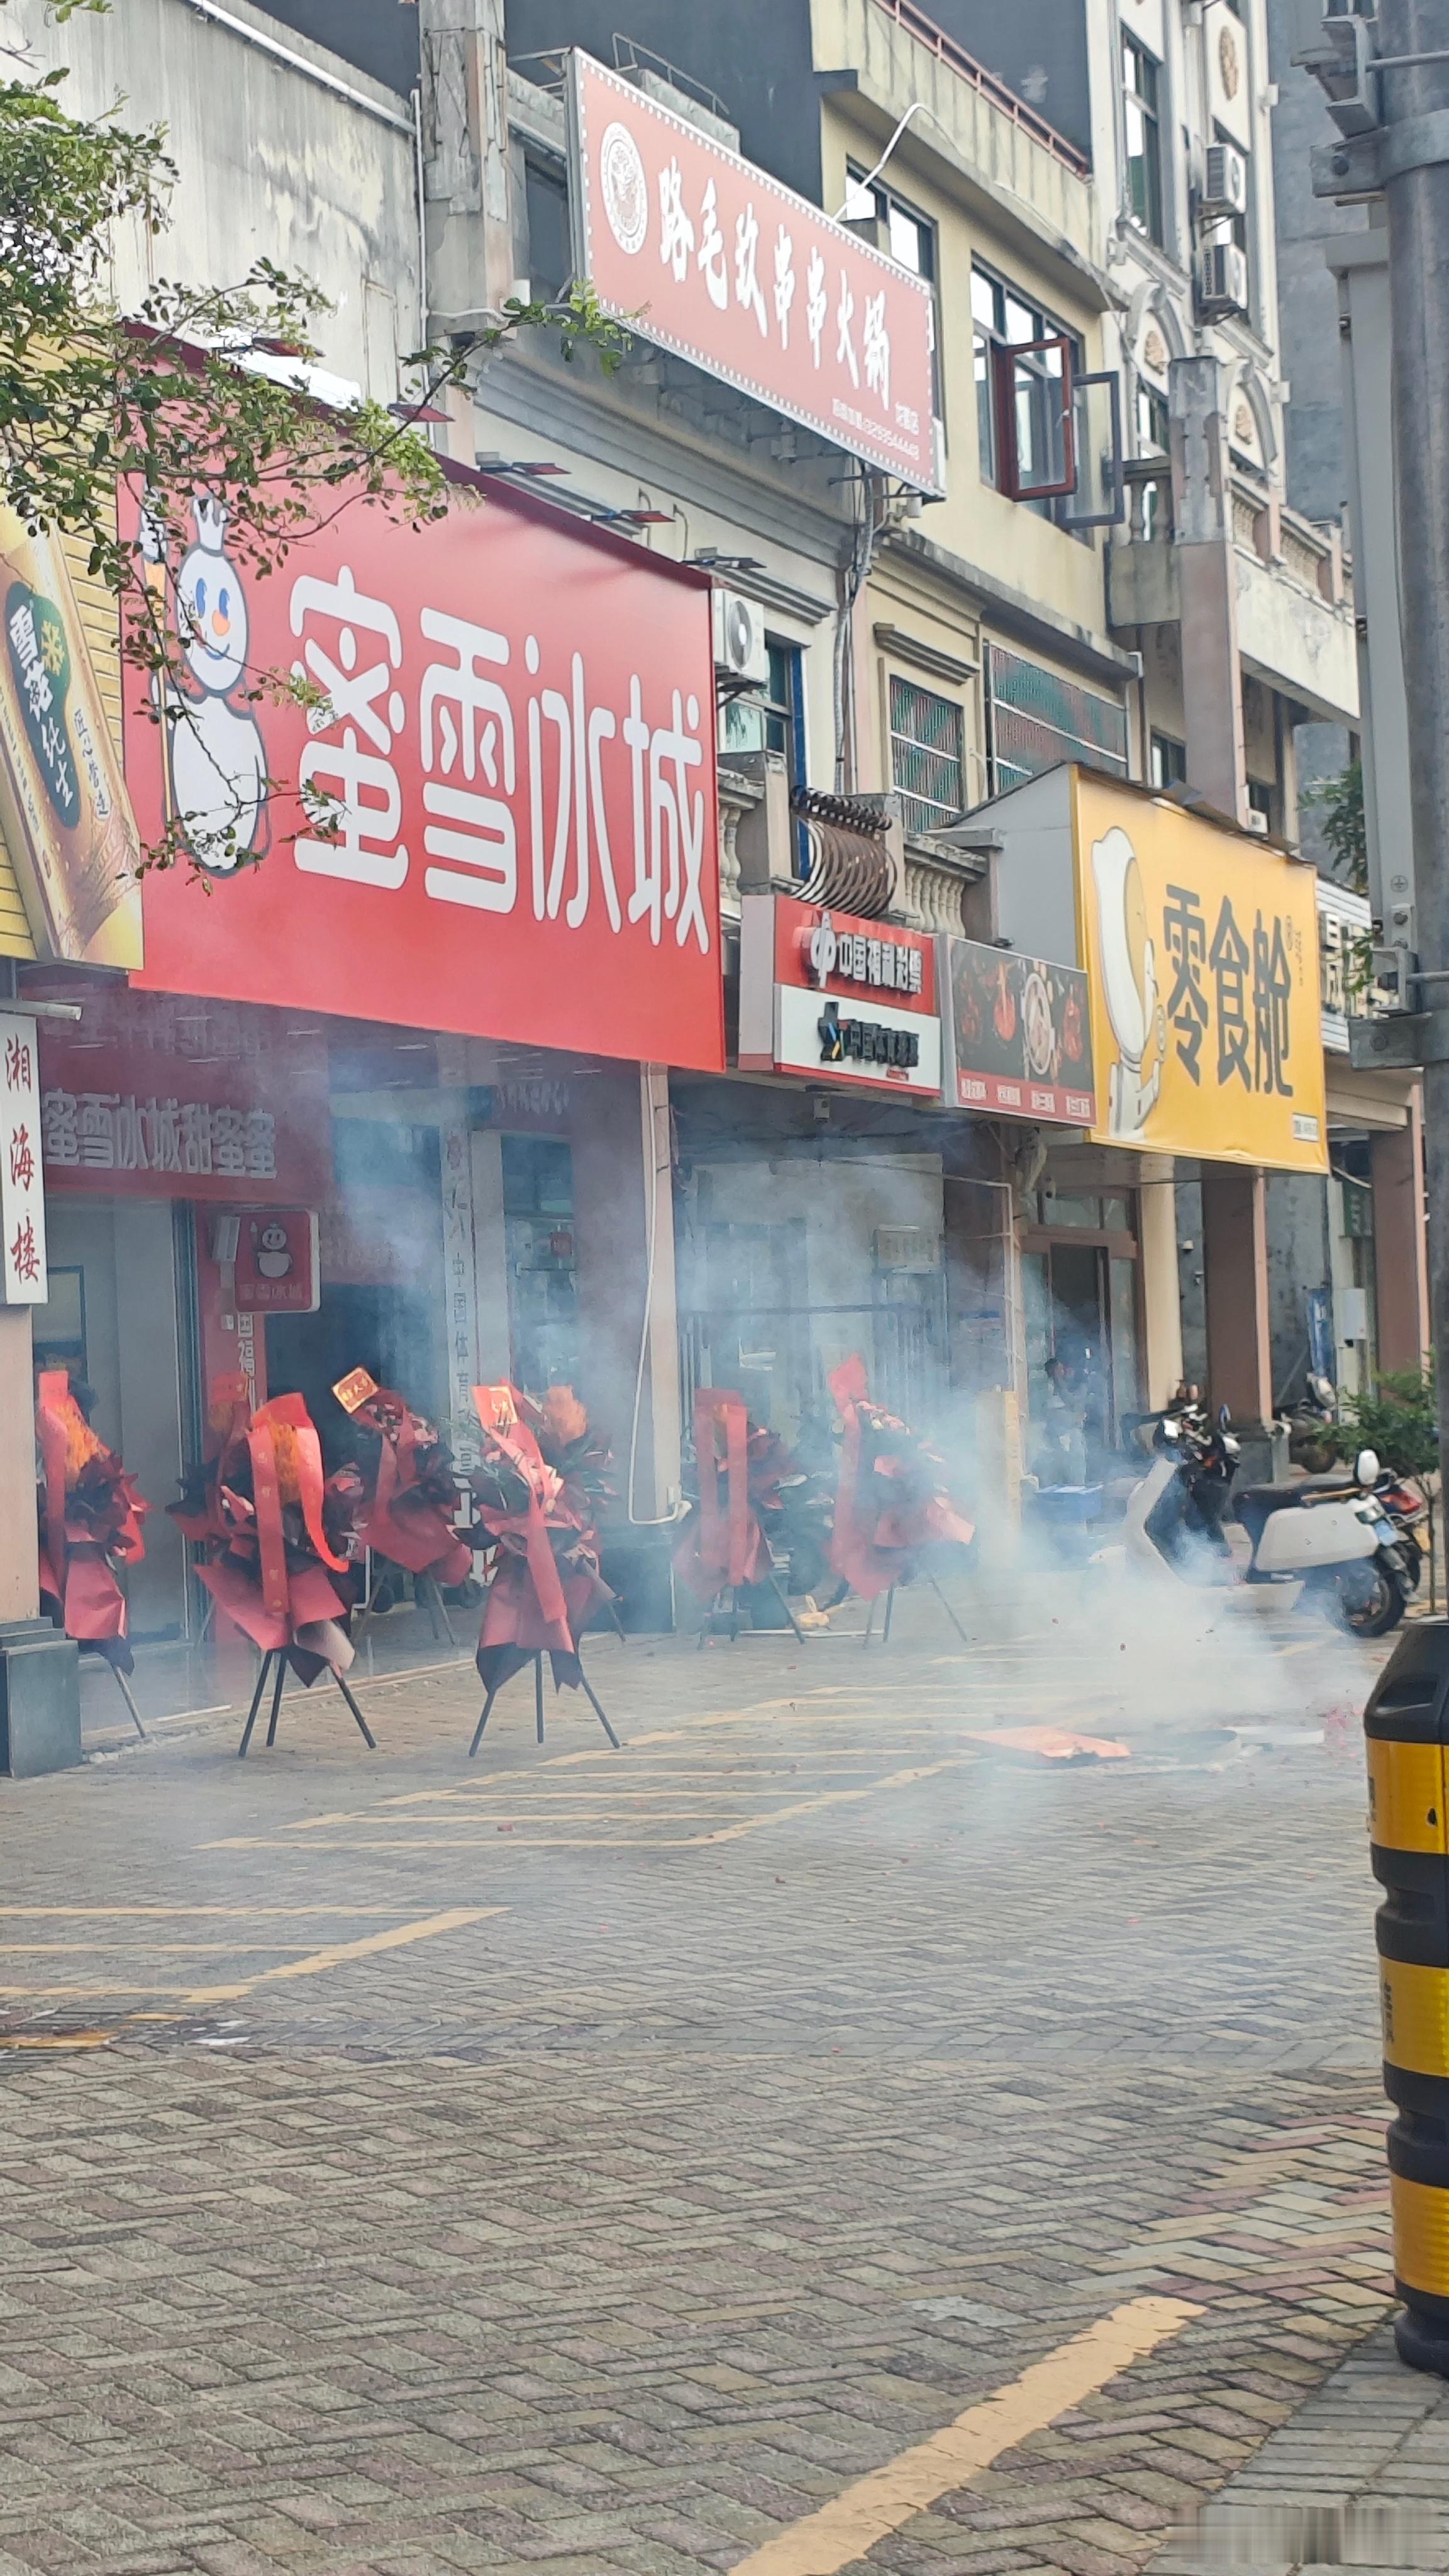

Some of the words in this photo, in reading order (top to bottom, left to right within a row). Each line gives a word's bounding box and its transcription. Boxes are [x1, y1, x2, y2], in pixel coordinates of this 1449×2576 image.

[10, 604, 74, 808] 雪花纯生
[290, 565, 709, 955] 蜜雪冰城
[838, 933, 922, 994] 中国福利彩票
[1163, 883, 1294, 1097] 零食舱
[5, 1034, 40, 1284] 湘海楼
[43, 1087, 277, 1179] 蜜雪冰城甜蜜蜜
